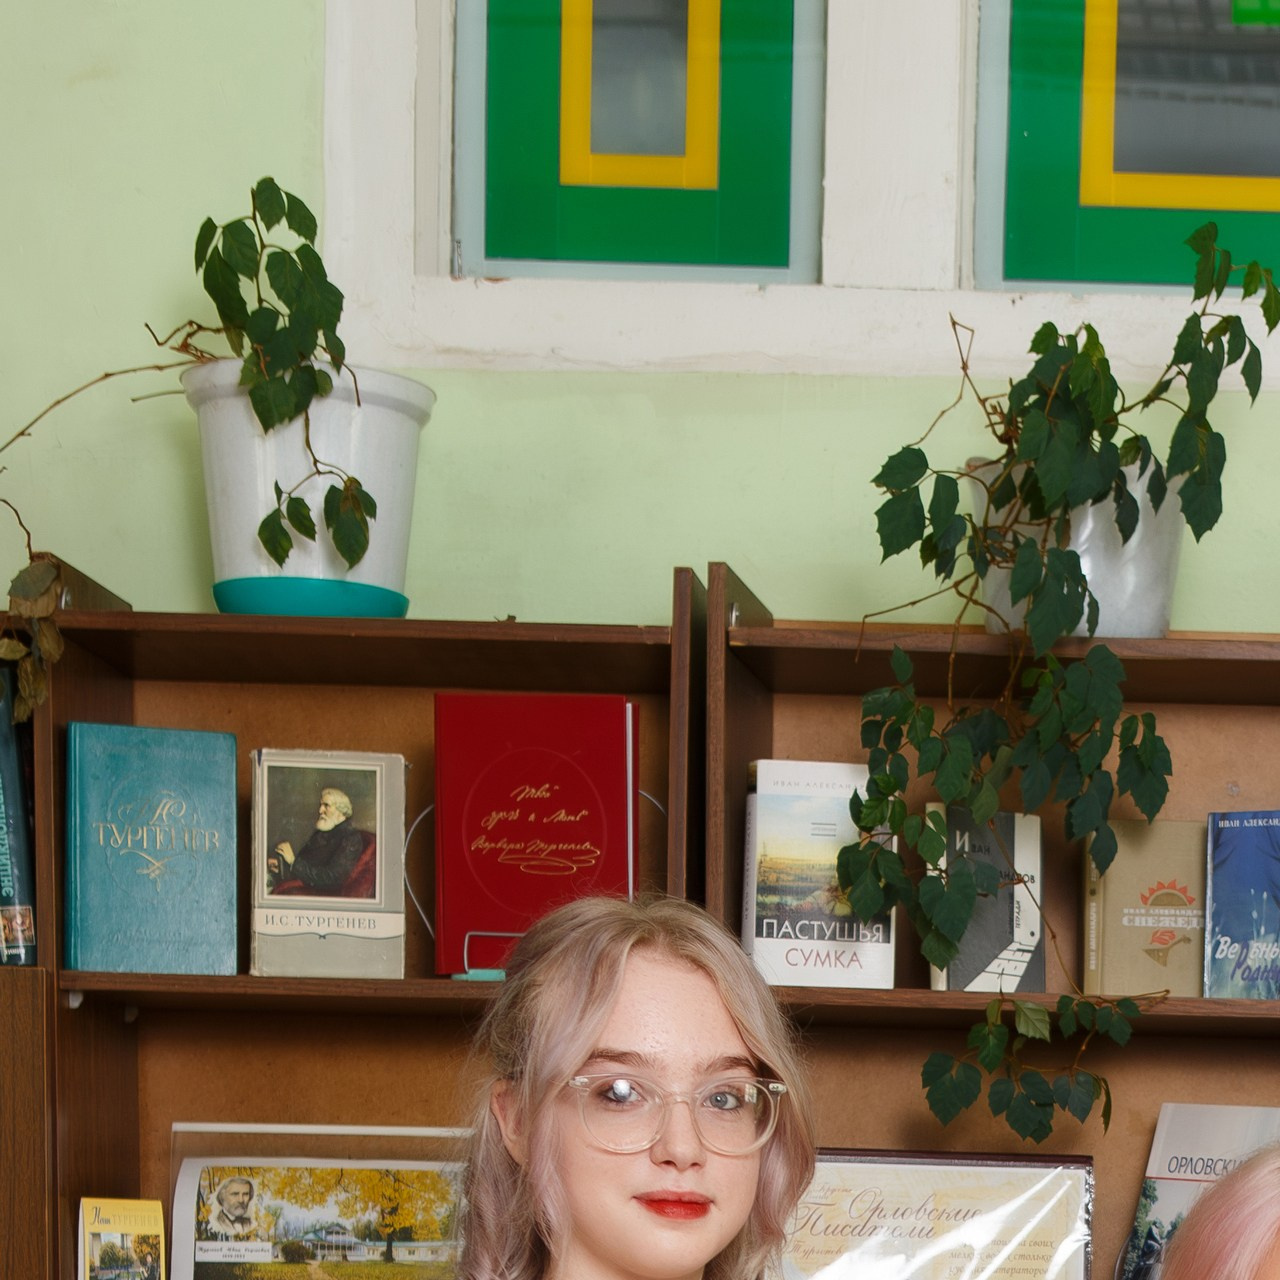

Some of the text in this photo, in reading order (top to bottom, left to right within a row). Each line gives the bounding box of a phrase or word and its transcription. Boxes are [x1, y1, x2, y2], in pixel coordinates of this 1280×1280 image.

[93, 822, 219, 851] ТУРГЕНЕВ
[1219, 820, 1240, 828] ИВАН
[763, 918, 883, 943] ПАСТУШЬЯ
[1122, 916, 1204, 931] СНЕЖЕД
[785, 948, 863, 970] СУМКА
[788, 1202, 936, 1238] Писатели
[848, 1187, 984, 1237] Орловские
